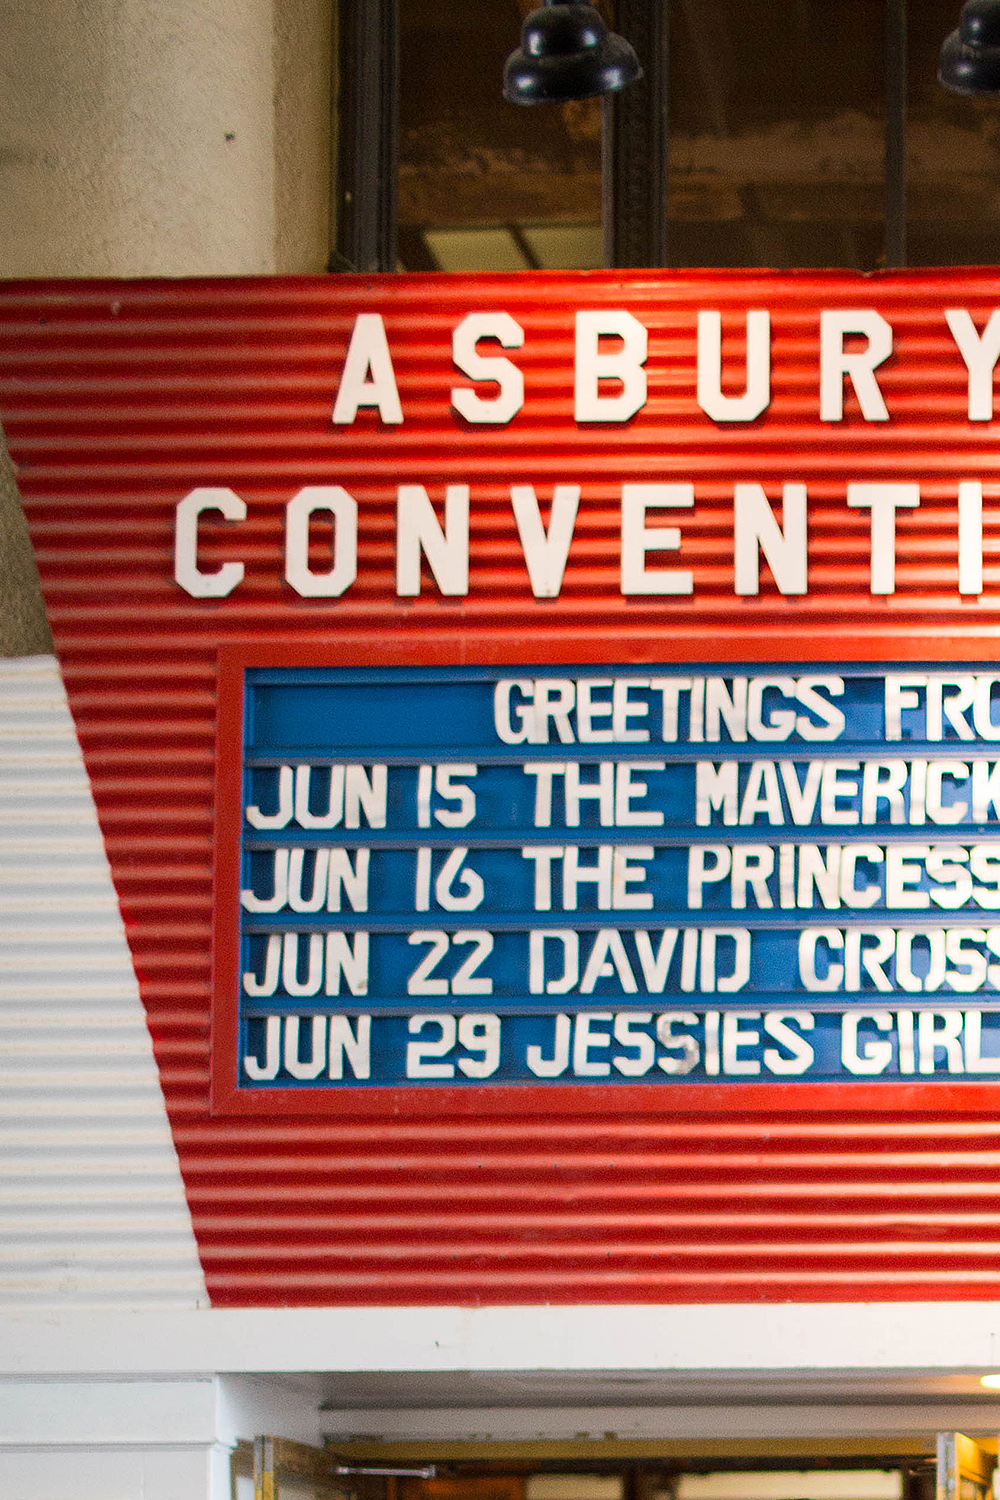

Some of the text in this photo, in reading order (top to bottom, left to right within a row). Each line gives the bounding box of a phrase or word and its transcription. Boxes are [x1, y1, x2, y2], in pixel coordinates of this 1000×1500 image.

[494, 676, 845, 744] GREETINGS
[247, 765, 387, 828] JUN
[418, 764, 476, 827] 15
[524, 761, 664, 826] THE
[241, 849, 369, 912] JUN
[416, 847, 483, 910] 16
[522, 845, 653, 910] THE
[244, 932, 368, 996] JUN
[408, 931, 493, 994] 22
[530, 927, 750, 993] DAVID
[245, 1016, 370, 1079] JUN
[407, 1014, 500, 1077] 29
[527, 1012, 814, 1076] JESSIES
